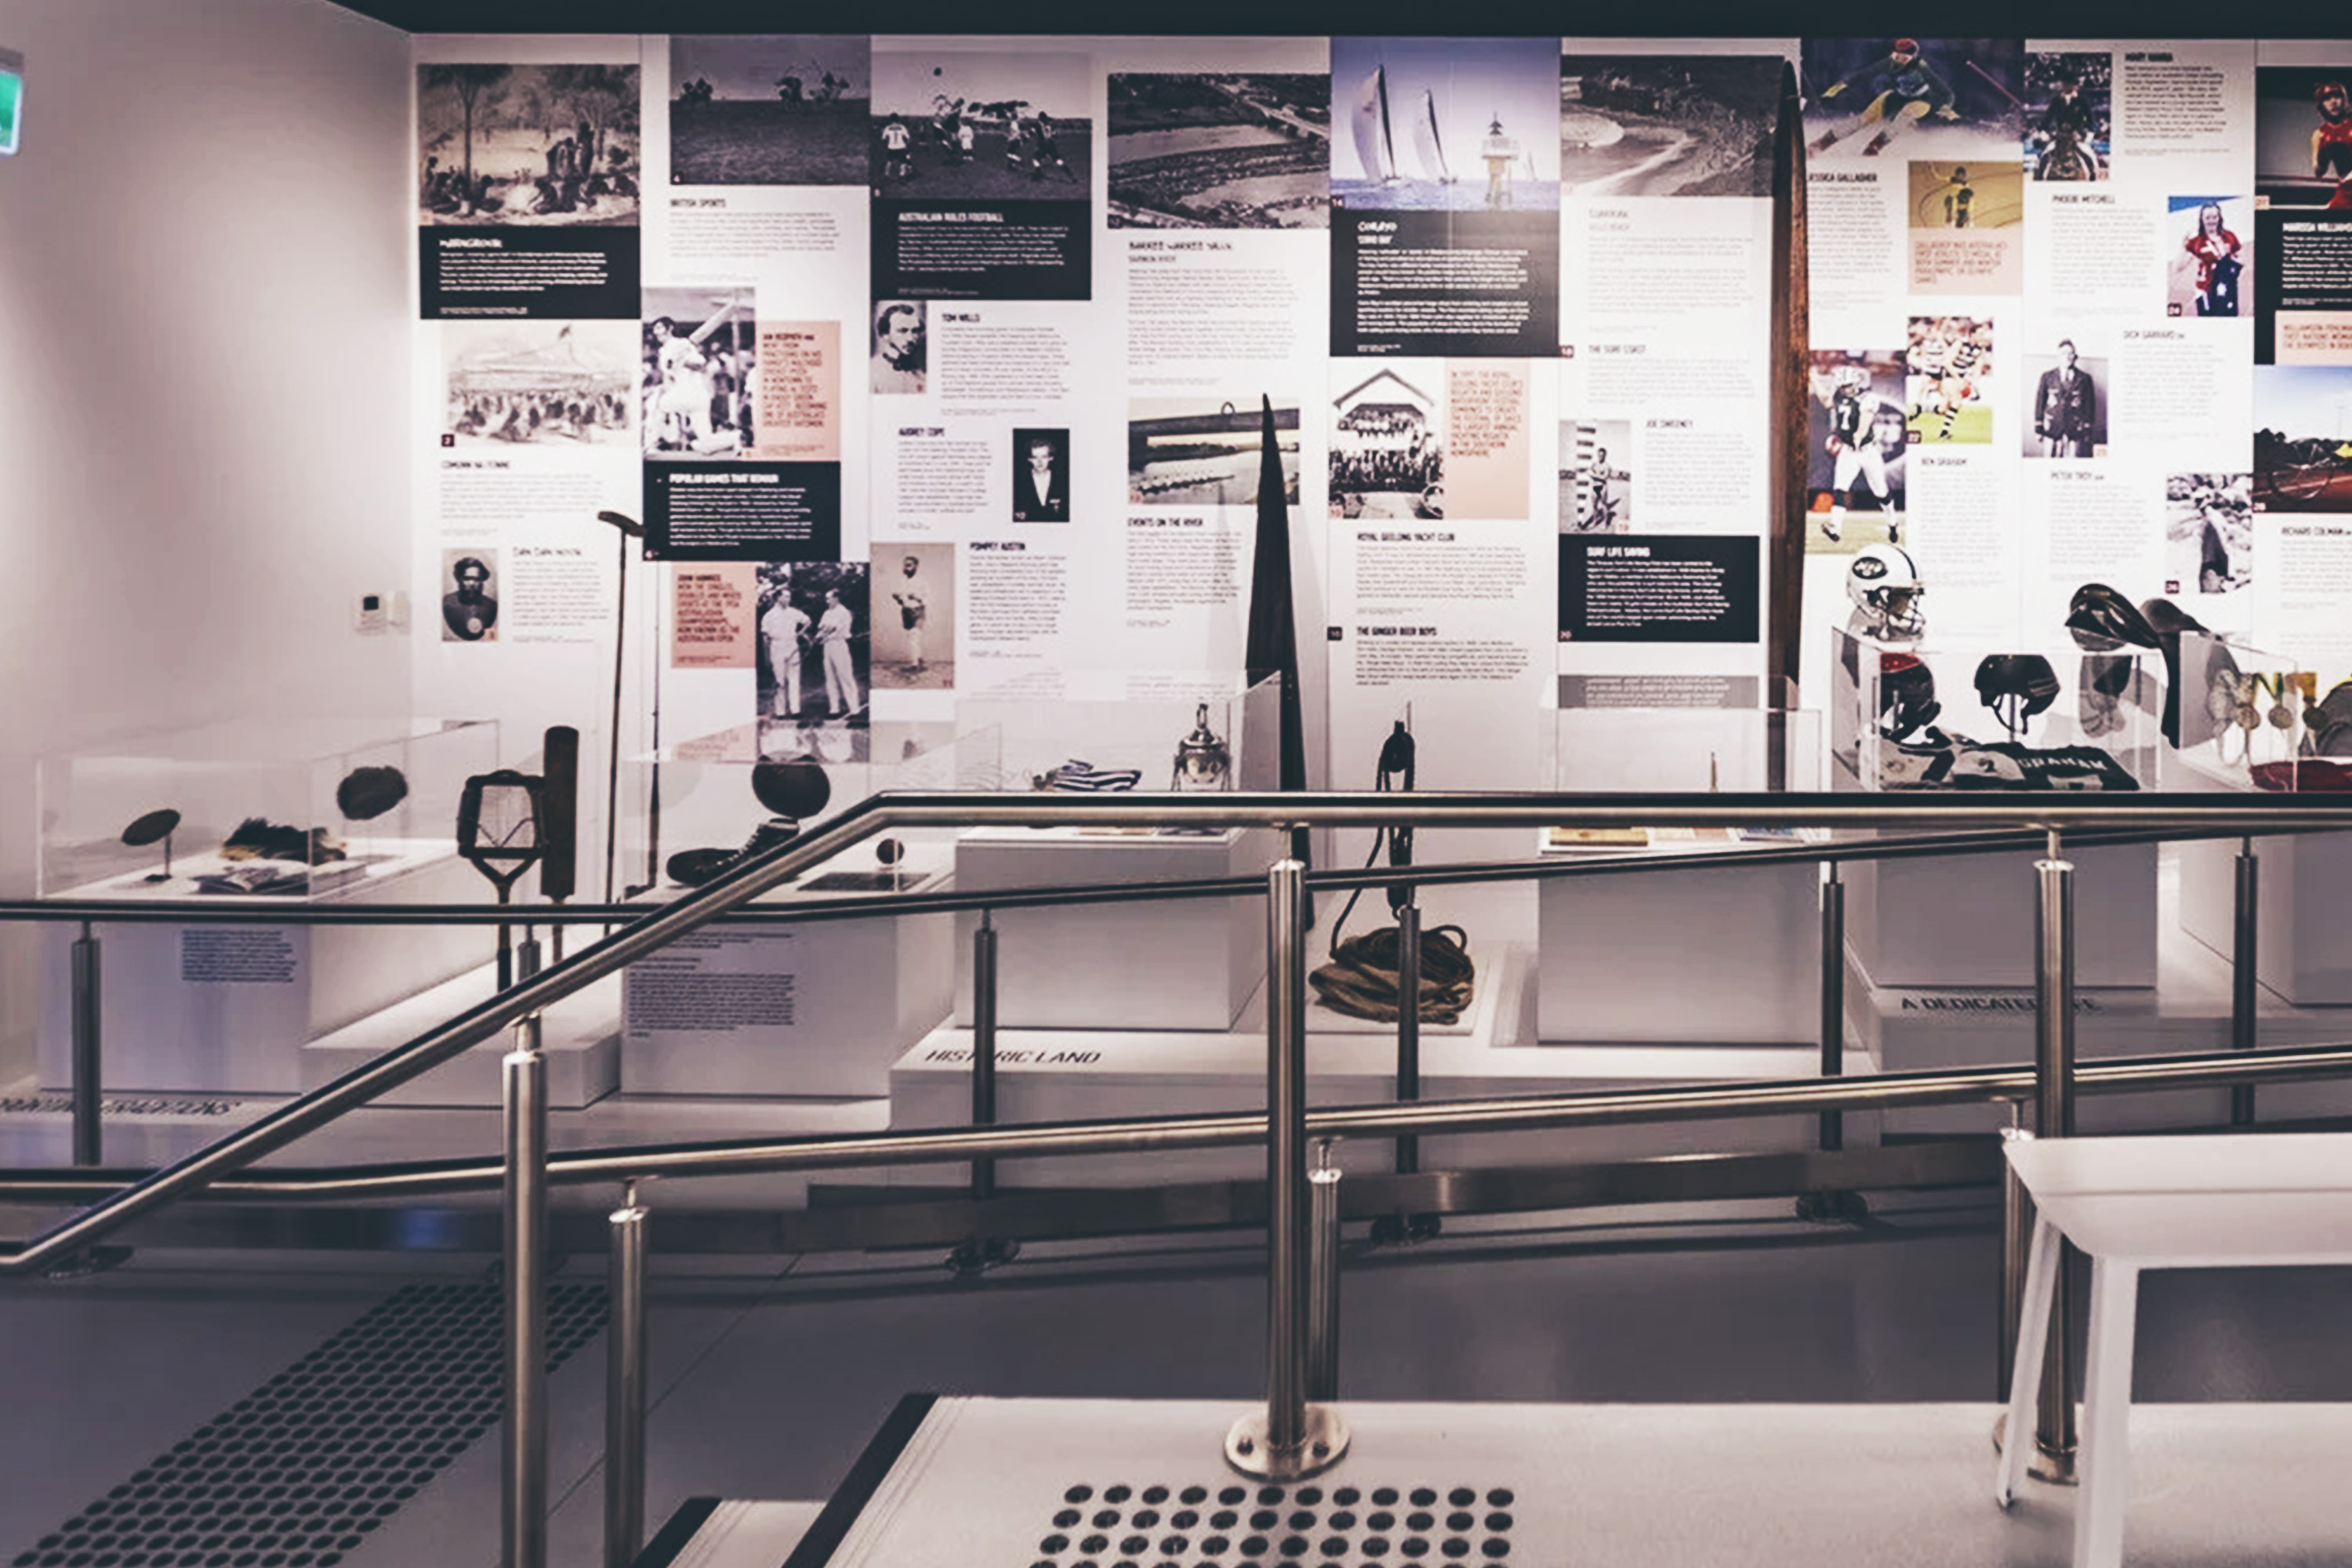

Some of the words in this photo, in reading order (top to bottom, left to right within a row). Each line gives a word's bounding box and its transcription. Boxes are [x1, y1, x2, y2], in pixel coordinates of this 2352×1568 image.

[967, 212, 1004, 222] FOOTBALL
[1838, 405, 1851, 430] 7
[1169, 518, 1181, 527] THE
[1356, 626, 1369, 636] THE
[1902, 997, 1918, 1010] A
[1035, 1051, 1101, 1063] LAND
